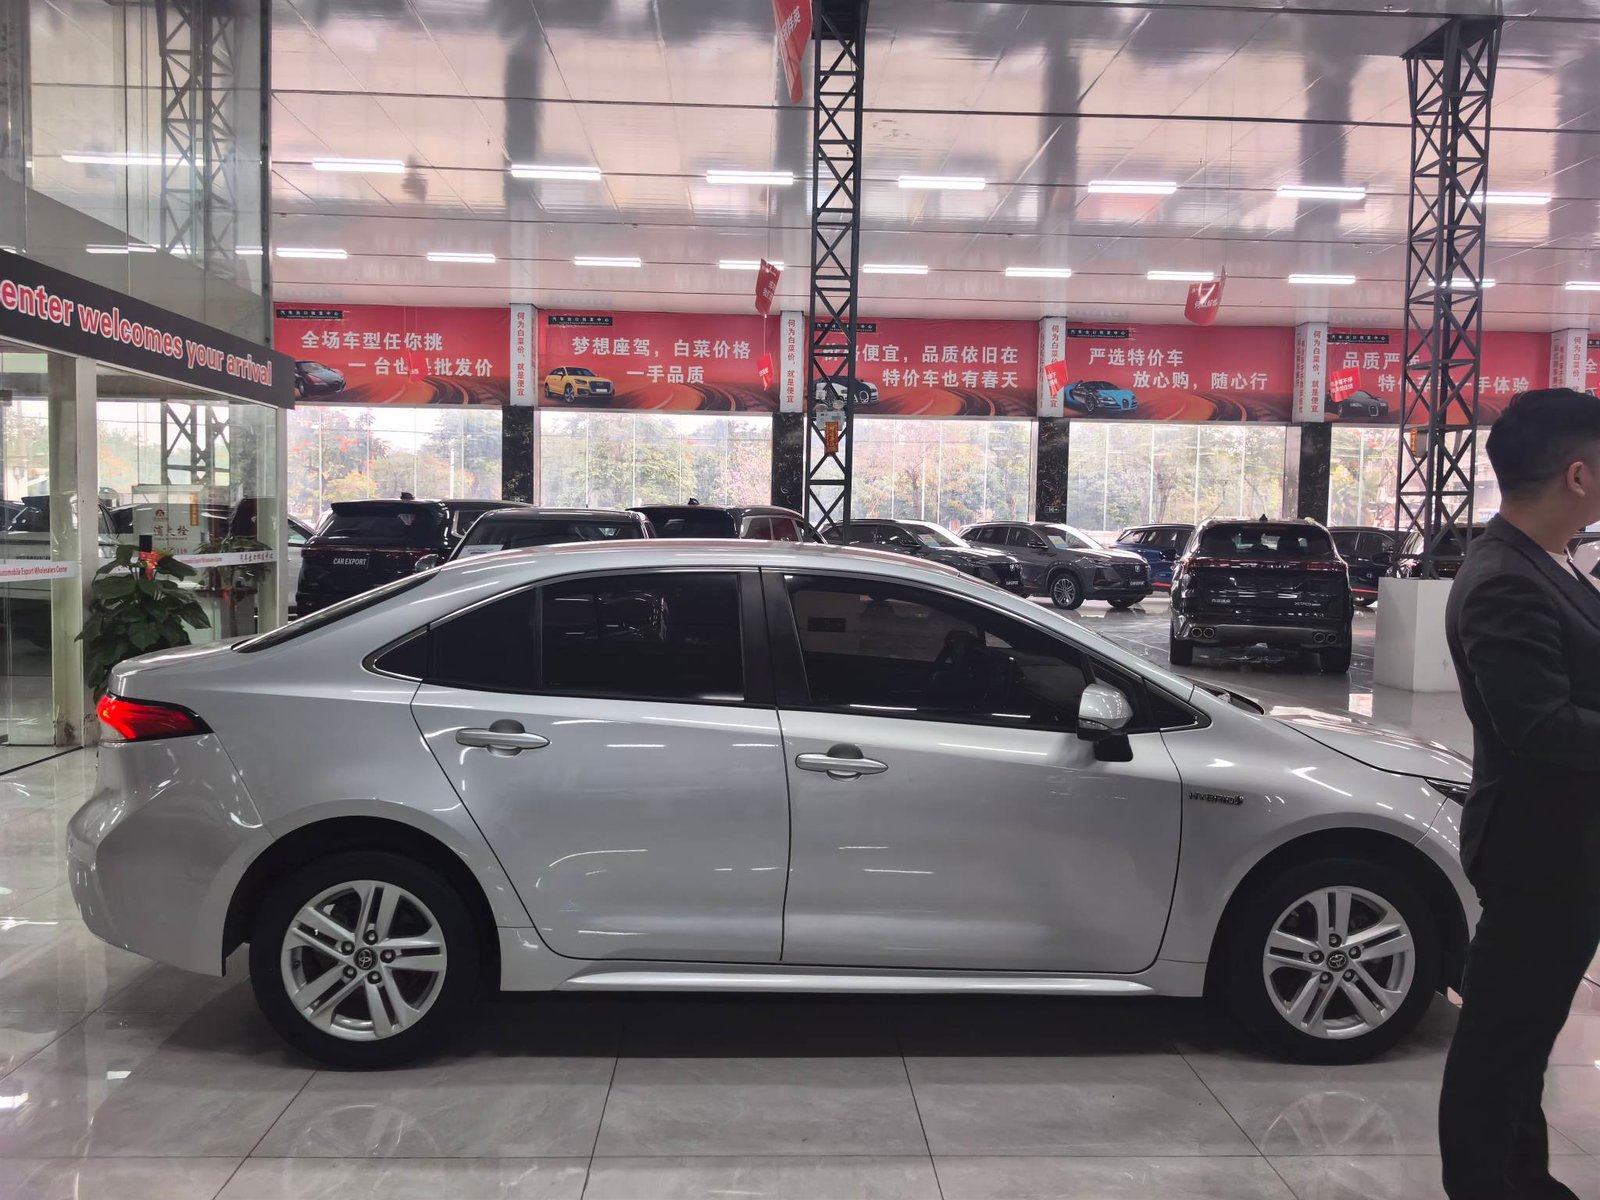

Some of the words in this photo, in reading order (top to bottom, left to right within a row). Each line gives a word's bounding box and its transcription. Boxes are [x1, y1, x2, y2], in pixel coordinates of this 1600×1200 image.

[78, 304, 183, 360] welcomes
[186, 338, 224, 371] your
[226, 354, 272, 386] arrival
[301, 330, 443, 351] 全场车型任你挑
[348, 357, 493, 378] 一台也批发价
[1088, 347, 1184, 367] 严选特价车
[626, 364, 705, 385] 一手品质
[882, 368, 1019, 389] 特价车也有春天
[333, 557, 345, 565] CAR
[345, 557, 367, 566] EXPORT
